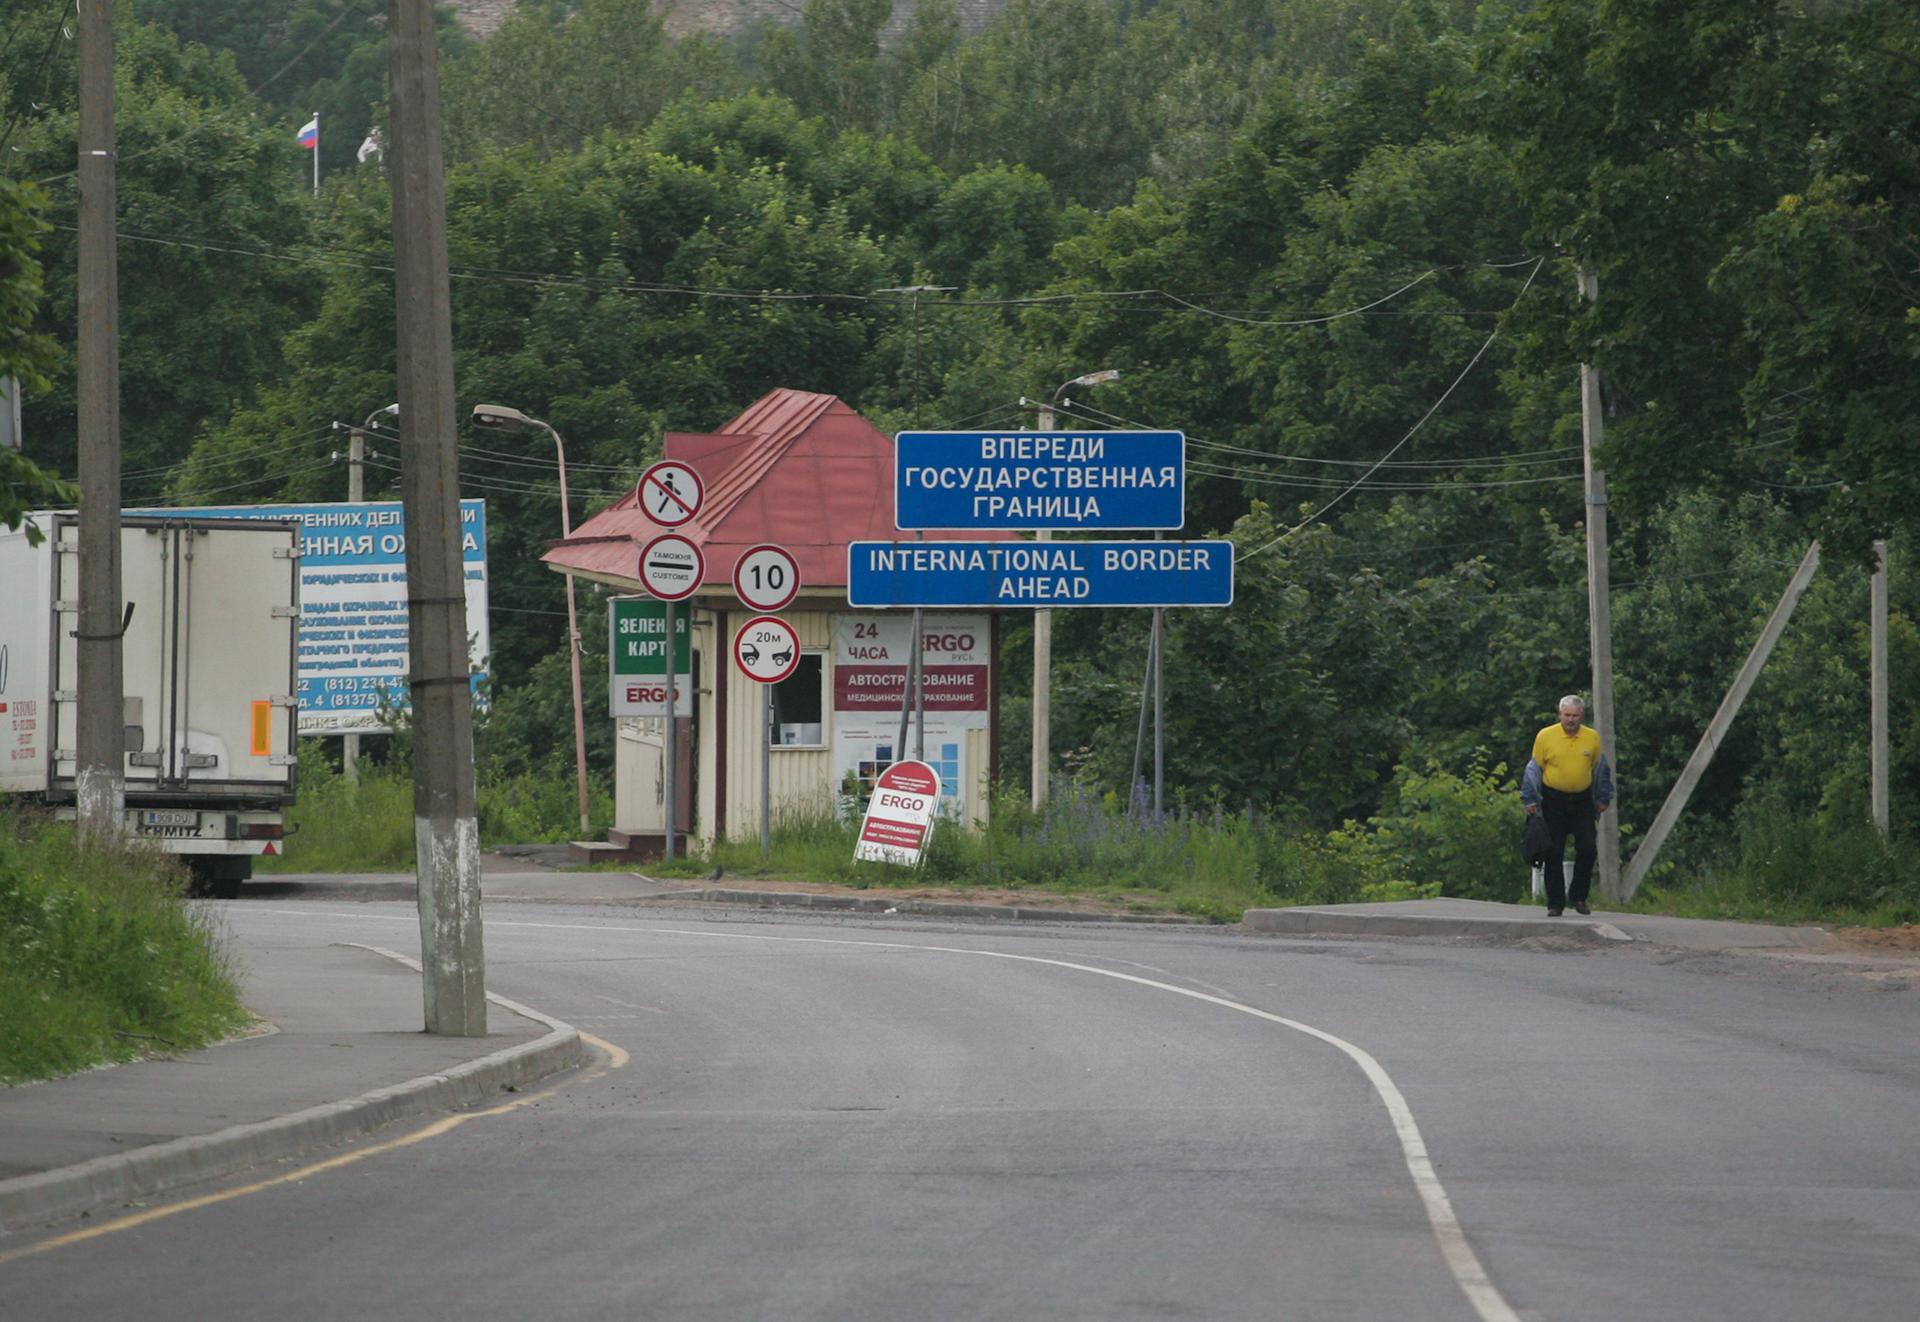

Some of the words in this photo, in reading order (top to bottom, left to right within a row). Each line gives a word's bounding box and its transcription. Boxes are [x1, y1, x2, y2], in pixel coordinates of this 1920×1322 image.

[981, 438, 1105, 462] ВПЕРЕДИ
[905, 467, 1176, 491] ГОСУДАРСТВЕННАЯ
[973, 496, 1101, 521] ГРАНИЦА
[366, 511, 400, 528] ДЕЛ
[653, 551, 692, 561] ТАМОЖНЯ
[869, 549, 1084, 572] INTERNATIONAL
[1104, 549, 1211, 571] BORDER
[652, 571, 689, 581] CUSTOMS
[750, 564, 784, 590] 10
[998, 577, 1090, 599] AHEAD
[619, 618, 685, 634] ЗЕЛЕНЯ
[855, 623, 879, 639] 24
[628, 641, 677, 657] КАРТ
[848, 646, 889, 660] ЧАСА
[325, 677, 358, 693] (812)
[315, 696, 324, 706] 4
[331, 694, 380, 708] (81375)
[880, 793, 924, 811] ERGO
